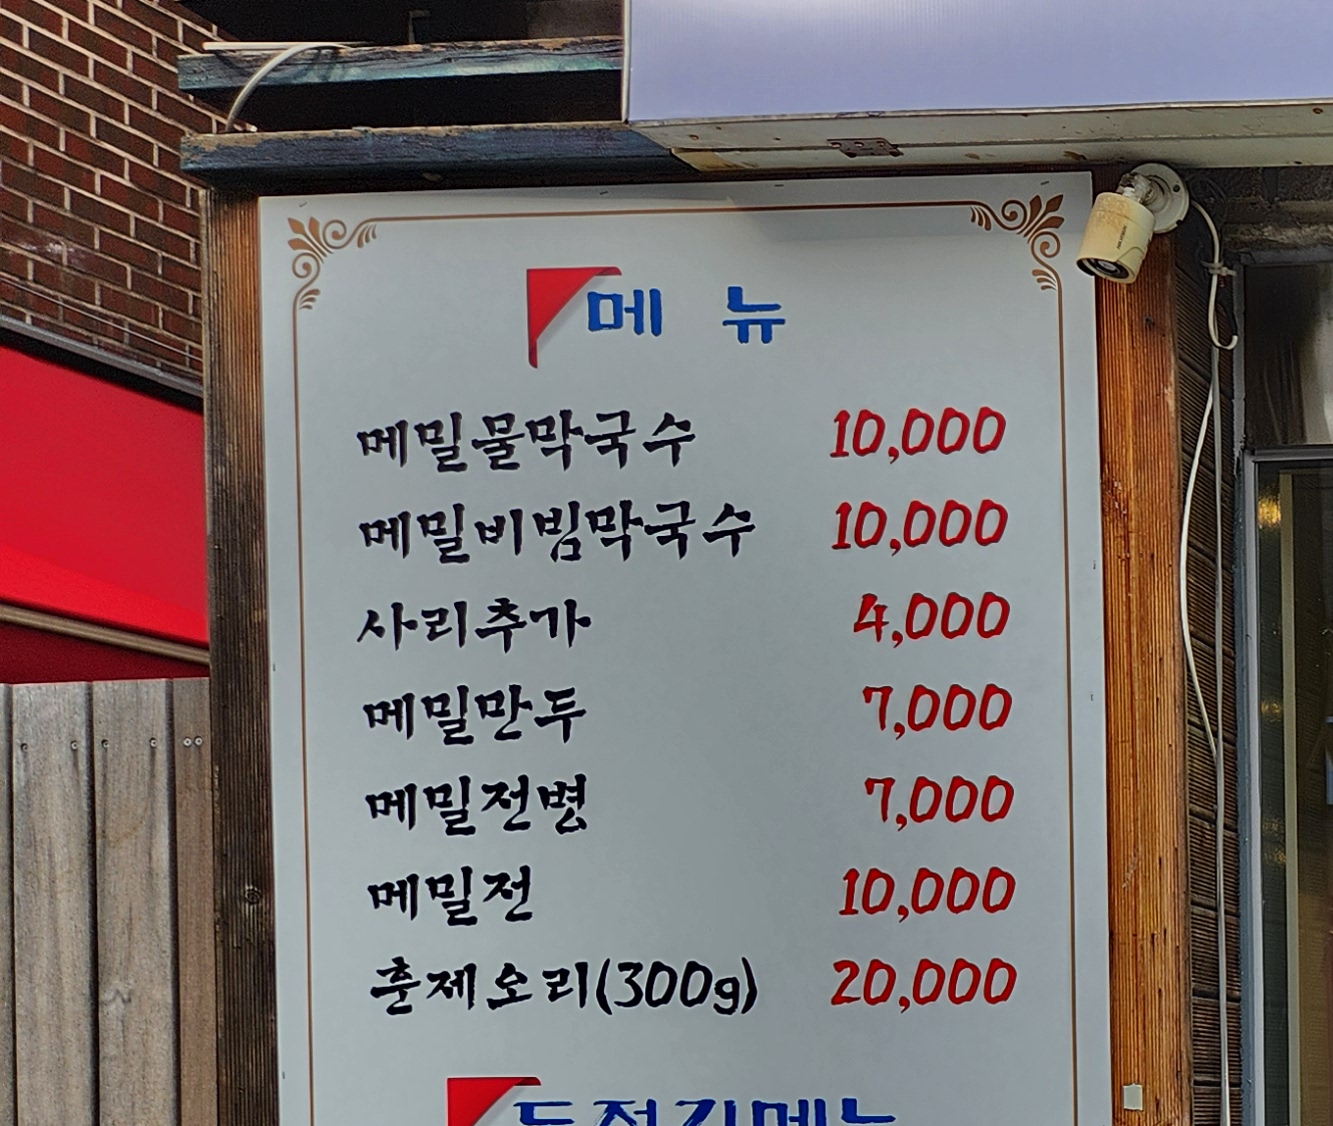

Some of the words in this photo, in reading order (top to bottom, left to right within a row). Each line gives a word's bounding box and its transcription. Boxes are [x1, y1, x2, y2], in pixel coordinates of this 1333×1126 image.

[357, 410, 695, 472] 메밀물막국수
[830, 407, 1006, 464] 10,000
[359, 500, 755, 563] 메밀비빔막국수
[832, 499, 1008, 556] 10,000
[357, 598, 591, 653] 사리추가
[854, 592, 1010, 648] 4,000
[363, 684, 586, 745] 메밀만두
[862, 684, 1012, 740] 7,000
[365, 774, 587, 835] 메밀전병
[864, 775, 1014, 831] 7,000
[367, 865, 532, 926] 메밀전
[839, 867, 1016, 923] 10,000
[370, 957, 757, 1015] 훈제오리(300g)
[831, 958, 1017, 1013] 20,000
